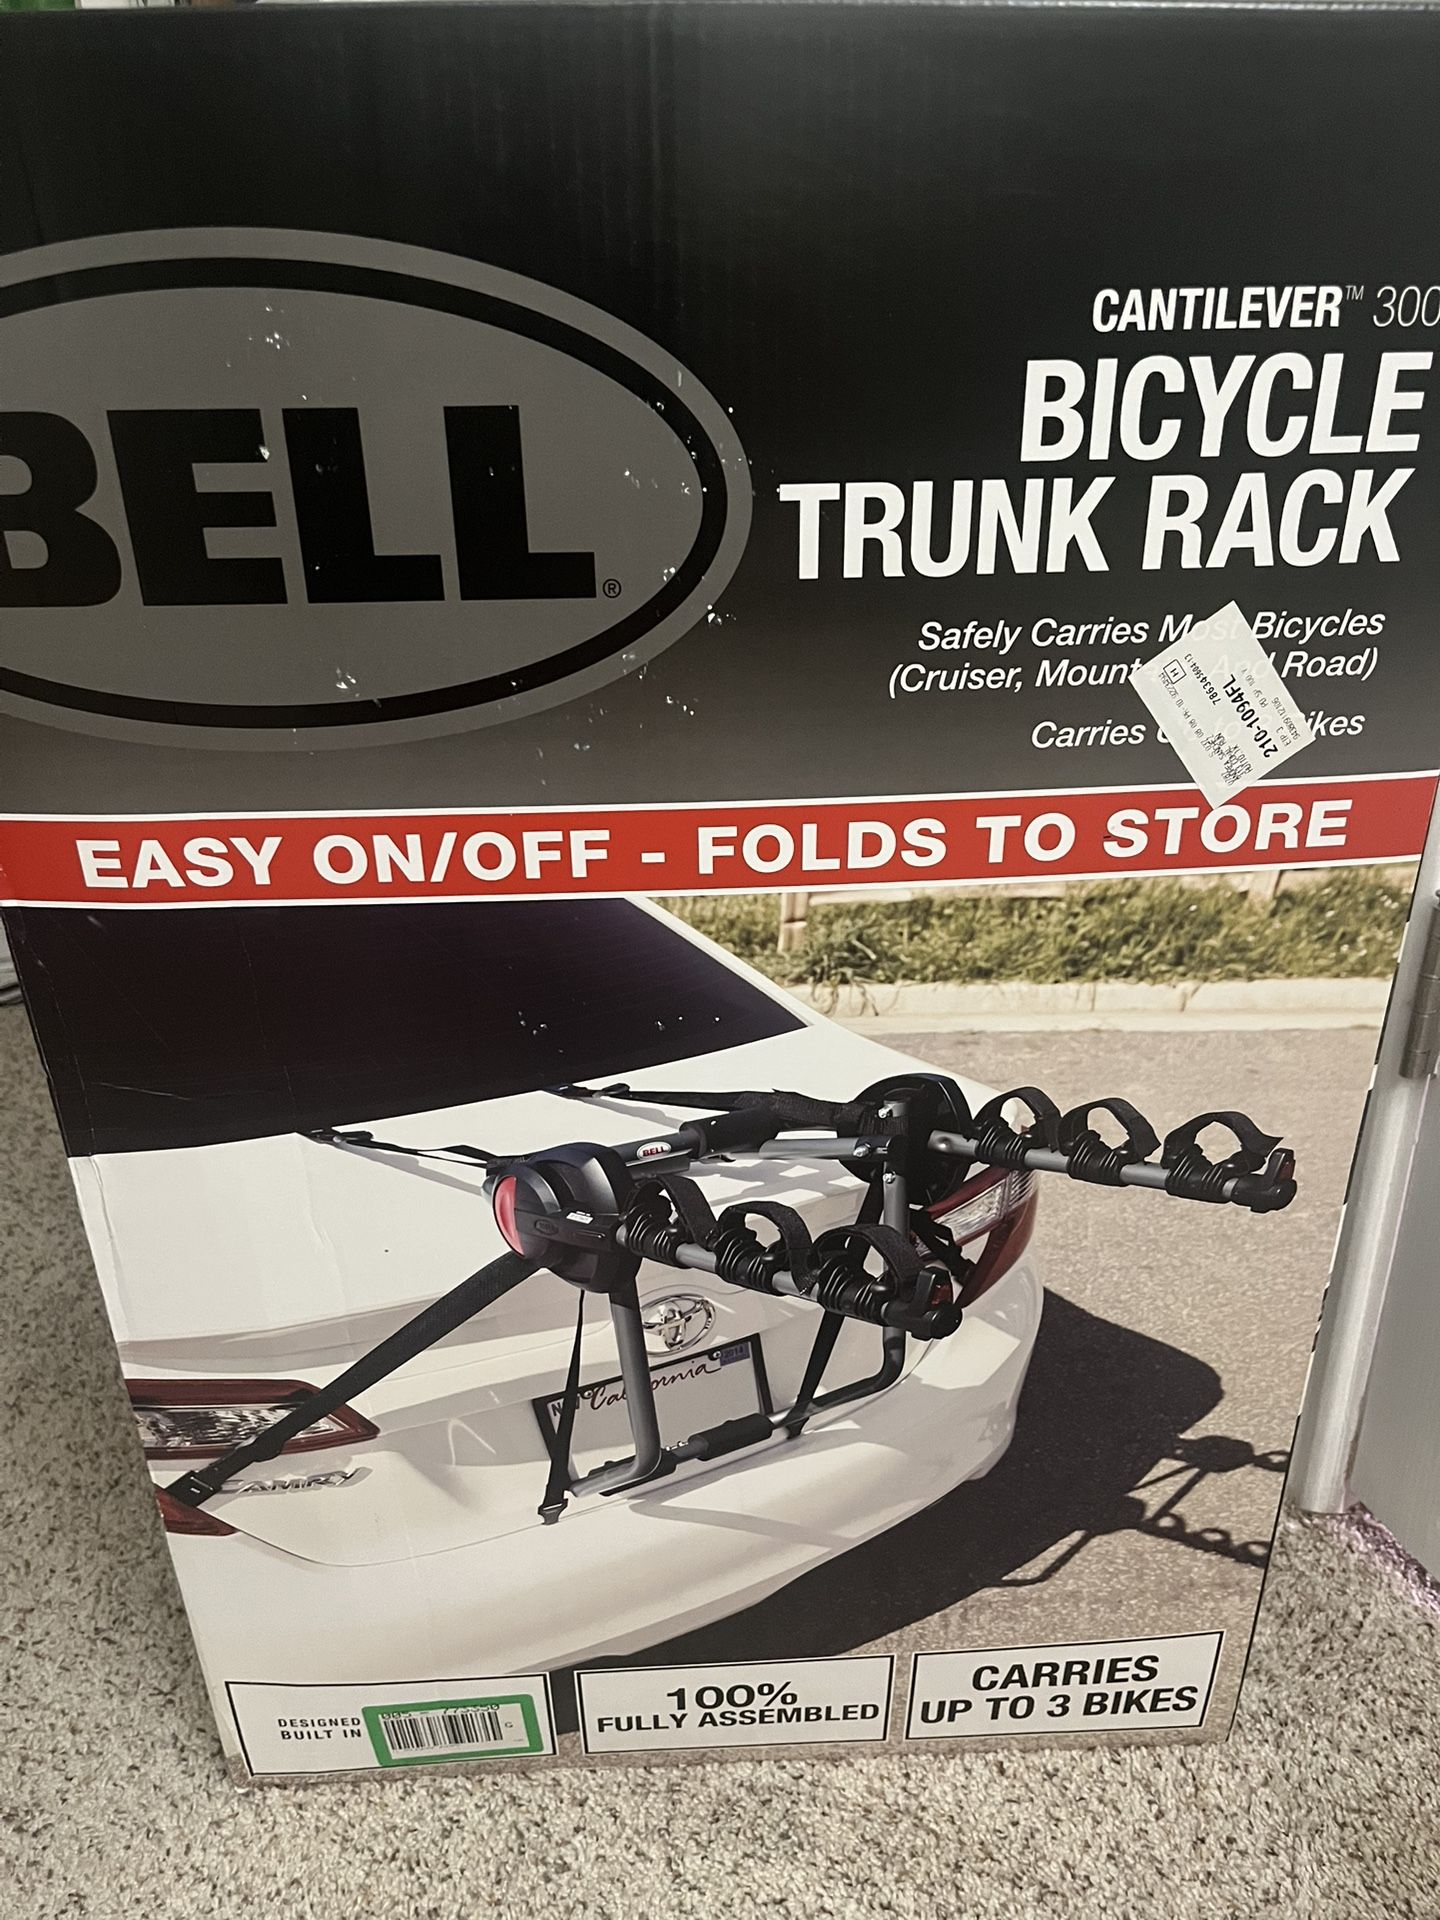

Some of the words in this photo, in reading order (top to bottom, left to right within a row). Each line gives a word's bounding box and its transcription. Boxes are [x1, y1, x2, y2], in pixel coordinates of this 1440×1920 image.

[1373, 286, 1440, 327] 300
[1021, 352, 1433, 461] BICYCLE
[780, 477, 1115, 579] TRUNK
[1143, 468, 1415, 569] RACK
[919, 620, 1021, 654] Safely
[1032, 617, 1149, 646] Carries
[1253, 610, 1386, 644] Bicycles
[888, 663, 1023, 699] (Cruiser,
[1281, 647, 1378, 680] Road)
[1169, 667, 1179, 678] H
[1031, 721, 1145, 749] Carries
[1303, 710, 1366, 738] ikes
[1216, 670, 1281, 758] 210-1094FL
[76, 837, 282, 888] EASY
[314, 830, 609, 884] ON/OFF
[698, 820, 946, 874] FOLDS
[976, 813, 1075, 863] TO
[1103, 800, 1352, 858] STORE
[642, 1146, 667, 1157] BELL
[973, 1656, 1159, 1690] CARRIES
[667, 1682, 798, 1710] 100%
[921, 1700, 972, 1723] UP
[986, 1696, 1034, 1720] TO
[1047, 1695, 1070, 1717] 3
[1084, 1687, 1198, 1715] BIKES
[278, 1718, 360, 1727] DESIGNED
[281, 1730, 332, 1739] BUILT
[343, 1729, 361, 1738] IN
[598, 1714, 687, 1732] FULLY
[698, 1704, 879, 1727] ASSEMBLED
